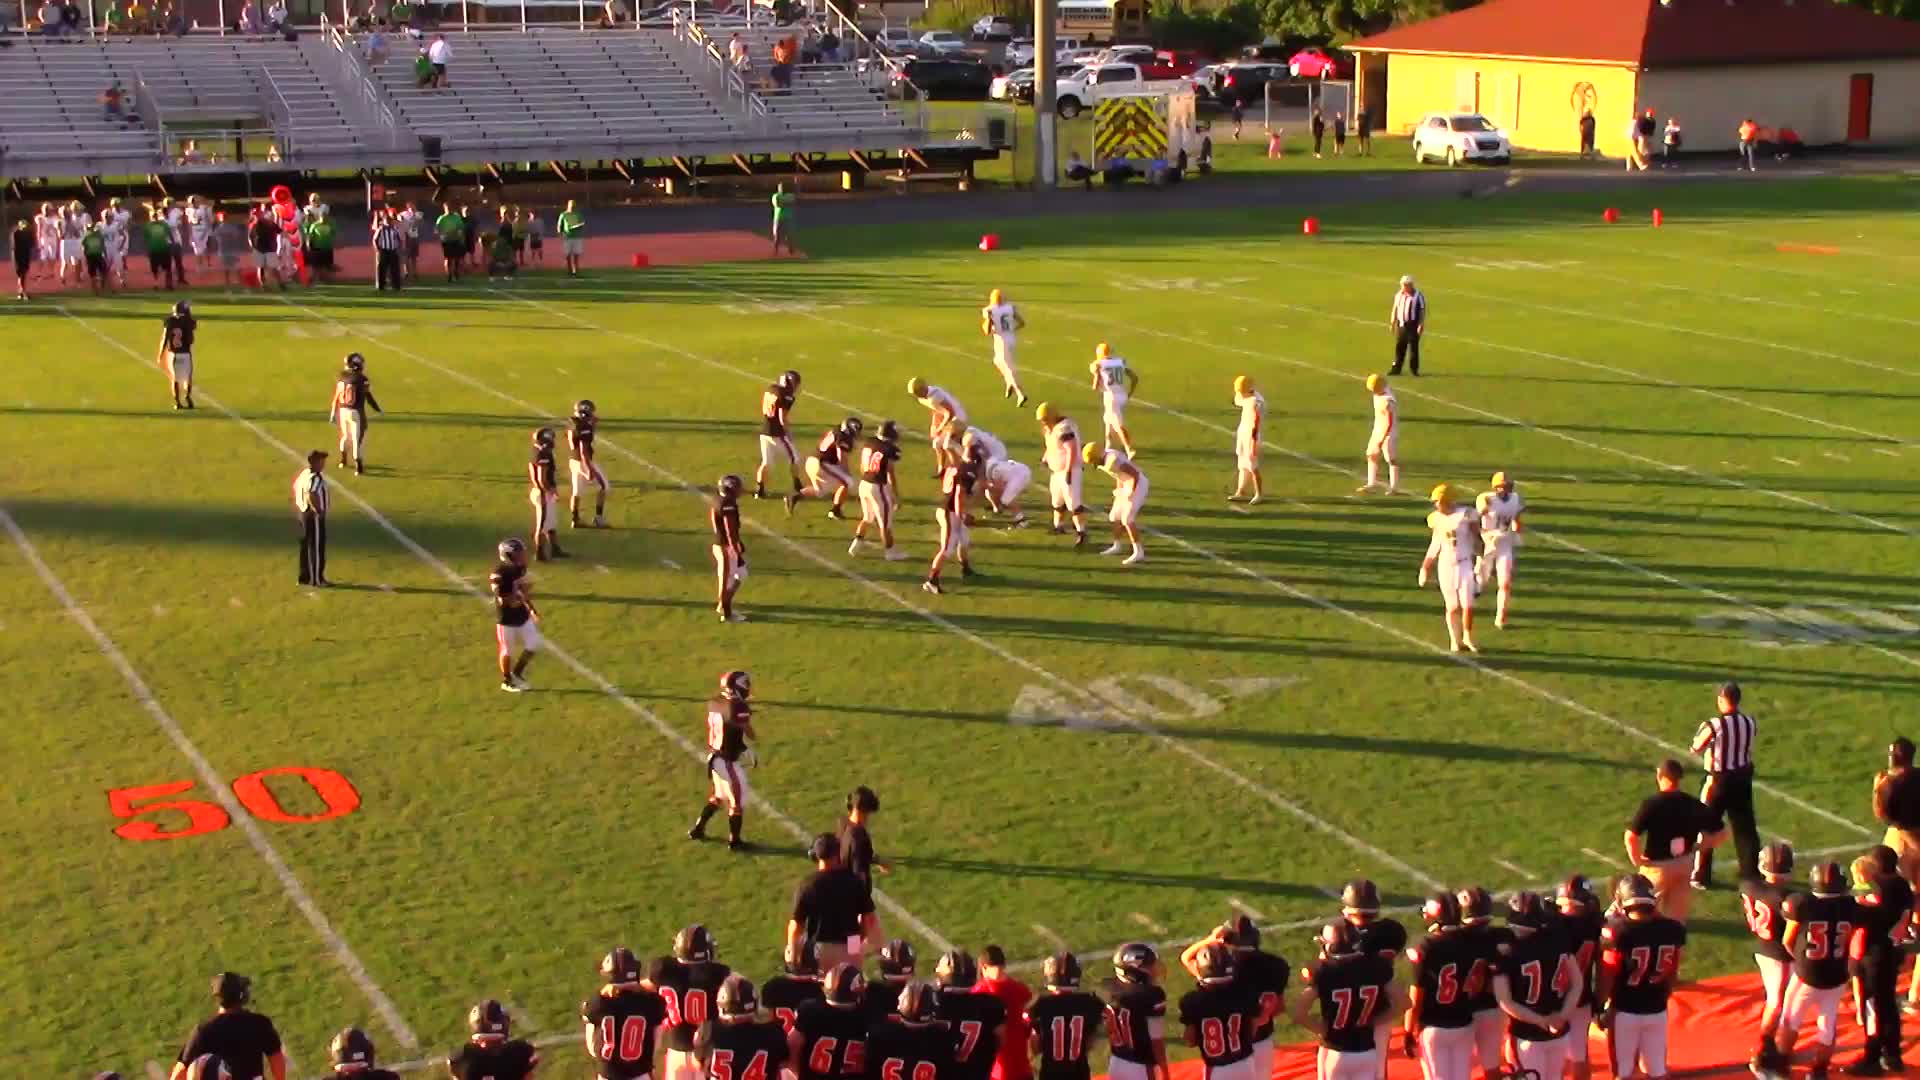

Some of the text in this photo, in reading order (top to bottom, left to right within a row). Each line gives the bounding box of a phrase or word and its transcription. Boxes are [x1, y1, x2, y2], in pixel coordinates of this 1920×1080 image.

[107, 766, 362, 841] 50
[1627, 944, 1679, 987] 75
[1331, 985, 1379, 1030] 77
[600, 1015, 647, 1061] 10
[1051, 1015, 1085, 1062] 11
[1202, 1013, 1243, 1057] 81
[709, 1048, 769, 1080] 54
